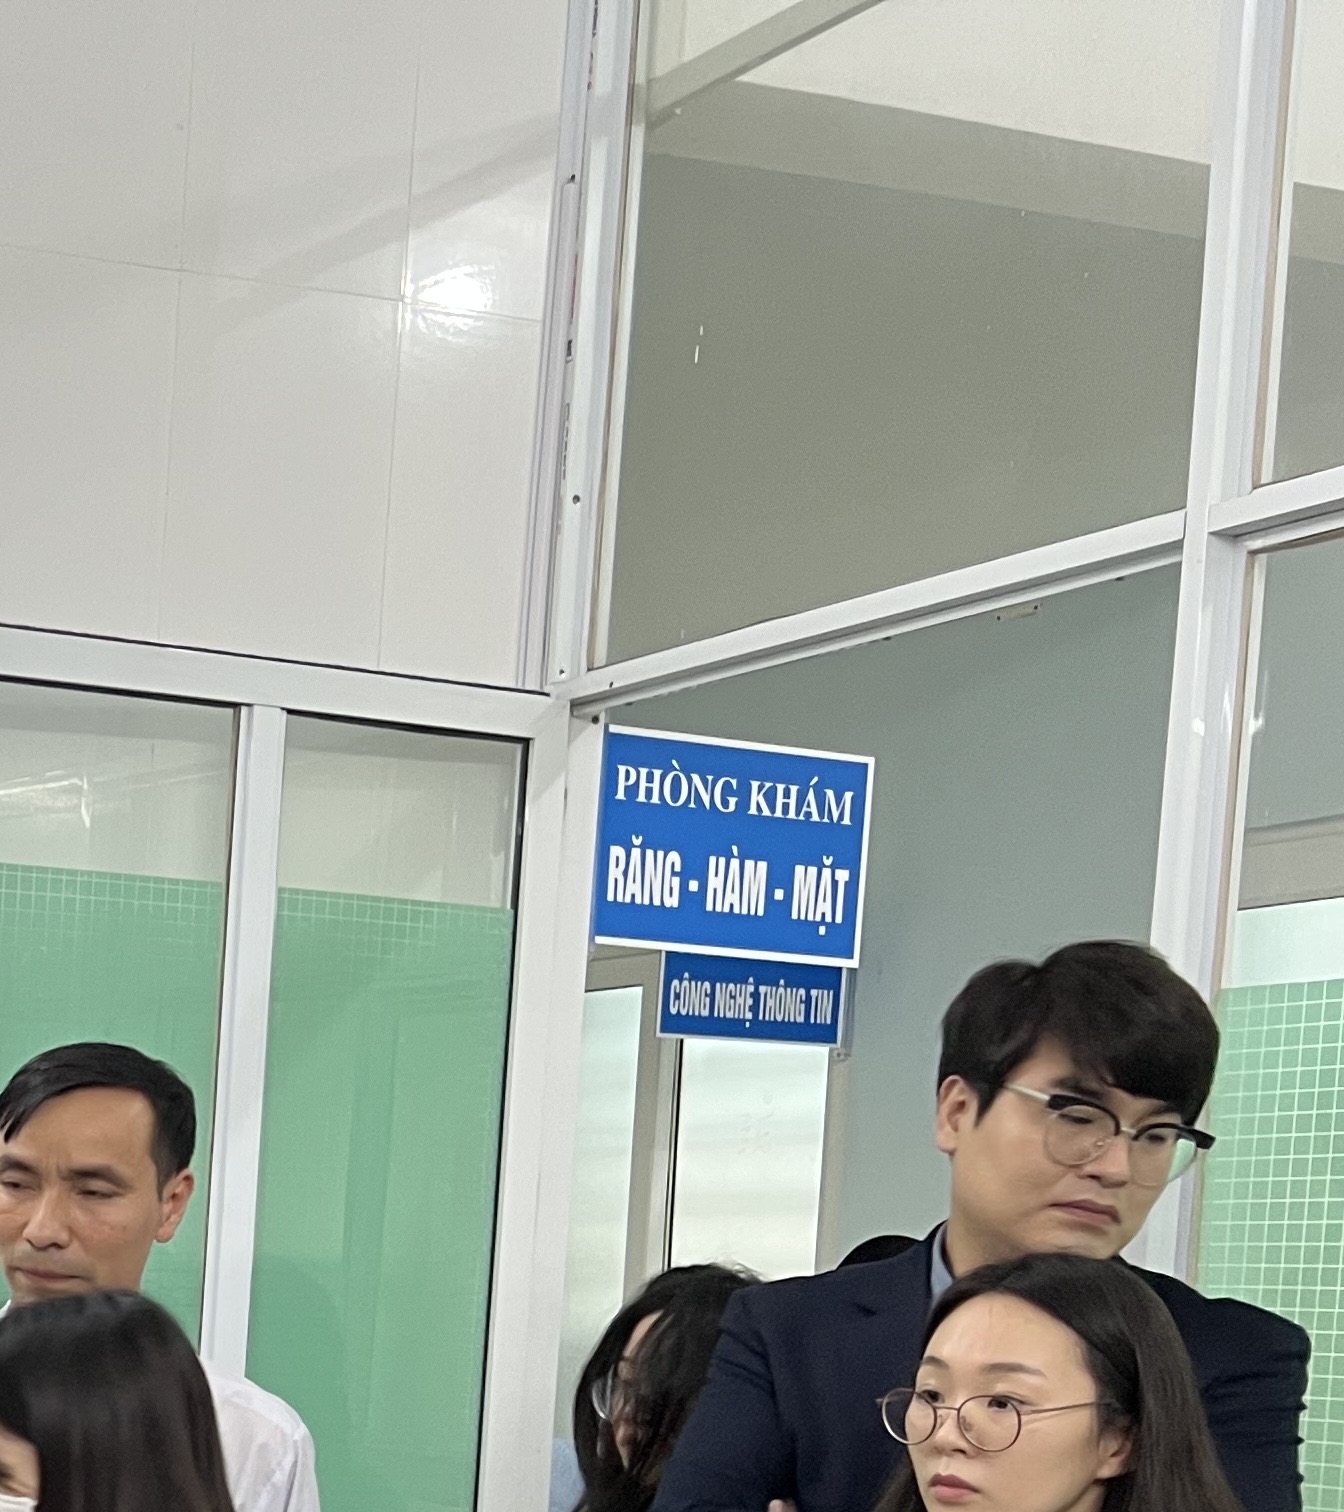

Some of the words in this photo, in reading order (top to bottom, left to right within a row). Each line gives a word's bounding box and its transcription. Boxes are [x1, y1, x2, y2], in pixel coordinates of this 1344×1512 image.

[614, 759, 739, 813] PHÒNG
[747, 776, 854, 826] KHÁM
[606, 834, 682, 908] RĂNG
[688, 879, 699, 893] -
[705, 845, 768, 917] HÀM
[773, 888, 785, 901] -
[791, 855, 850, 936] MẶT
[669, 971, 711, 1017] CÔNG
[713, 976, 755, 1029] NGHỆ
[758, 978, 806, 1024] THÔNG
[810, 988, 834, 1025] TIN
